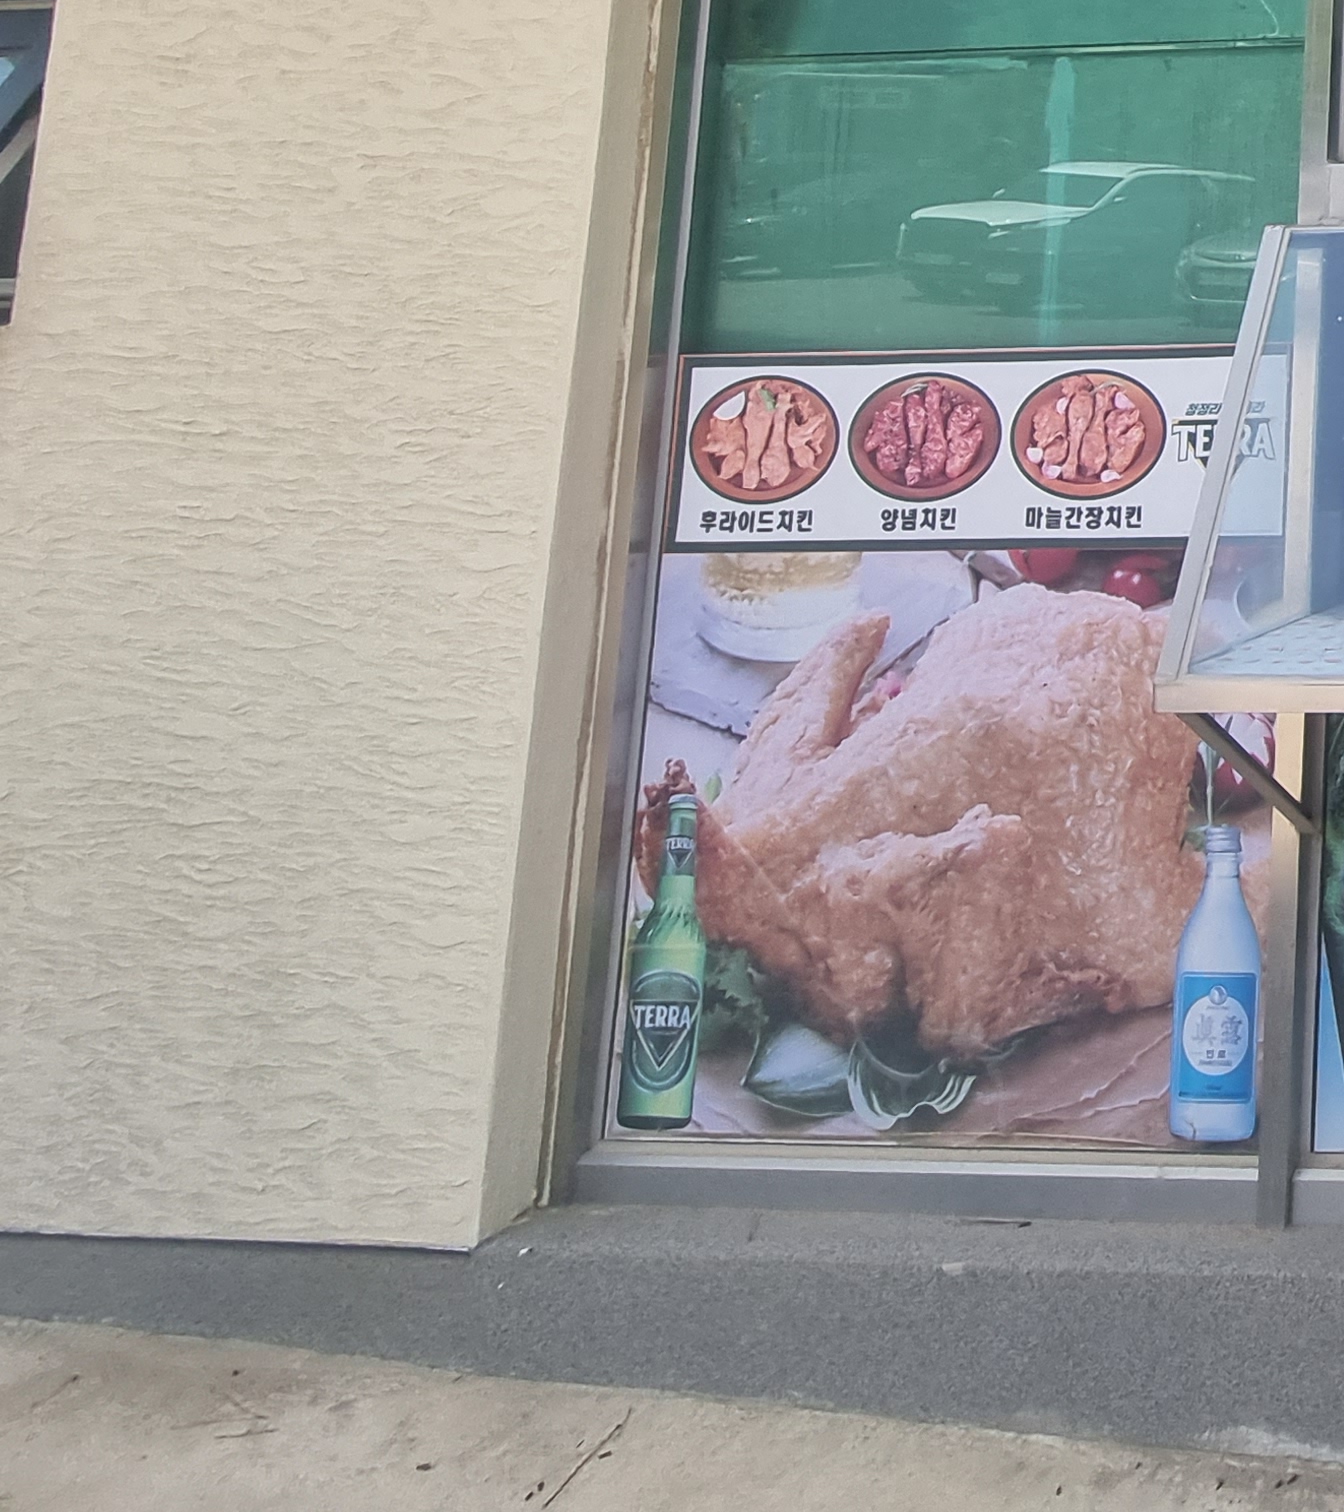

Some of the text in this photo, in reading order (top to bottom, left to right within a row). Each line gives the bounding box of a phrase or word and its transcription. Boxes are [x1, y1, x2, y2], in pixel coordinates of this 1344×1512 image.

[1171, 420, 1276, 462] TERA
[699, 508, 814, 534] 후라이드치킨
[880, 505, 958, 532] 양념치킨
[1024, 504, 1143, 531] 마늘간장치킨
[633, 1004, 692, 1030] TERRA
